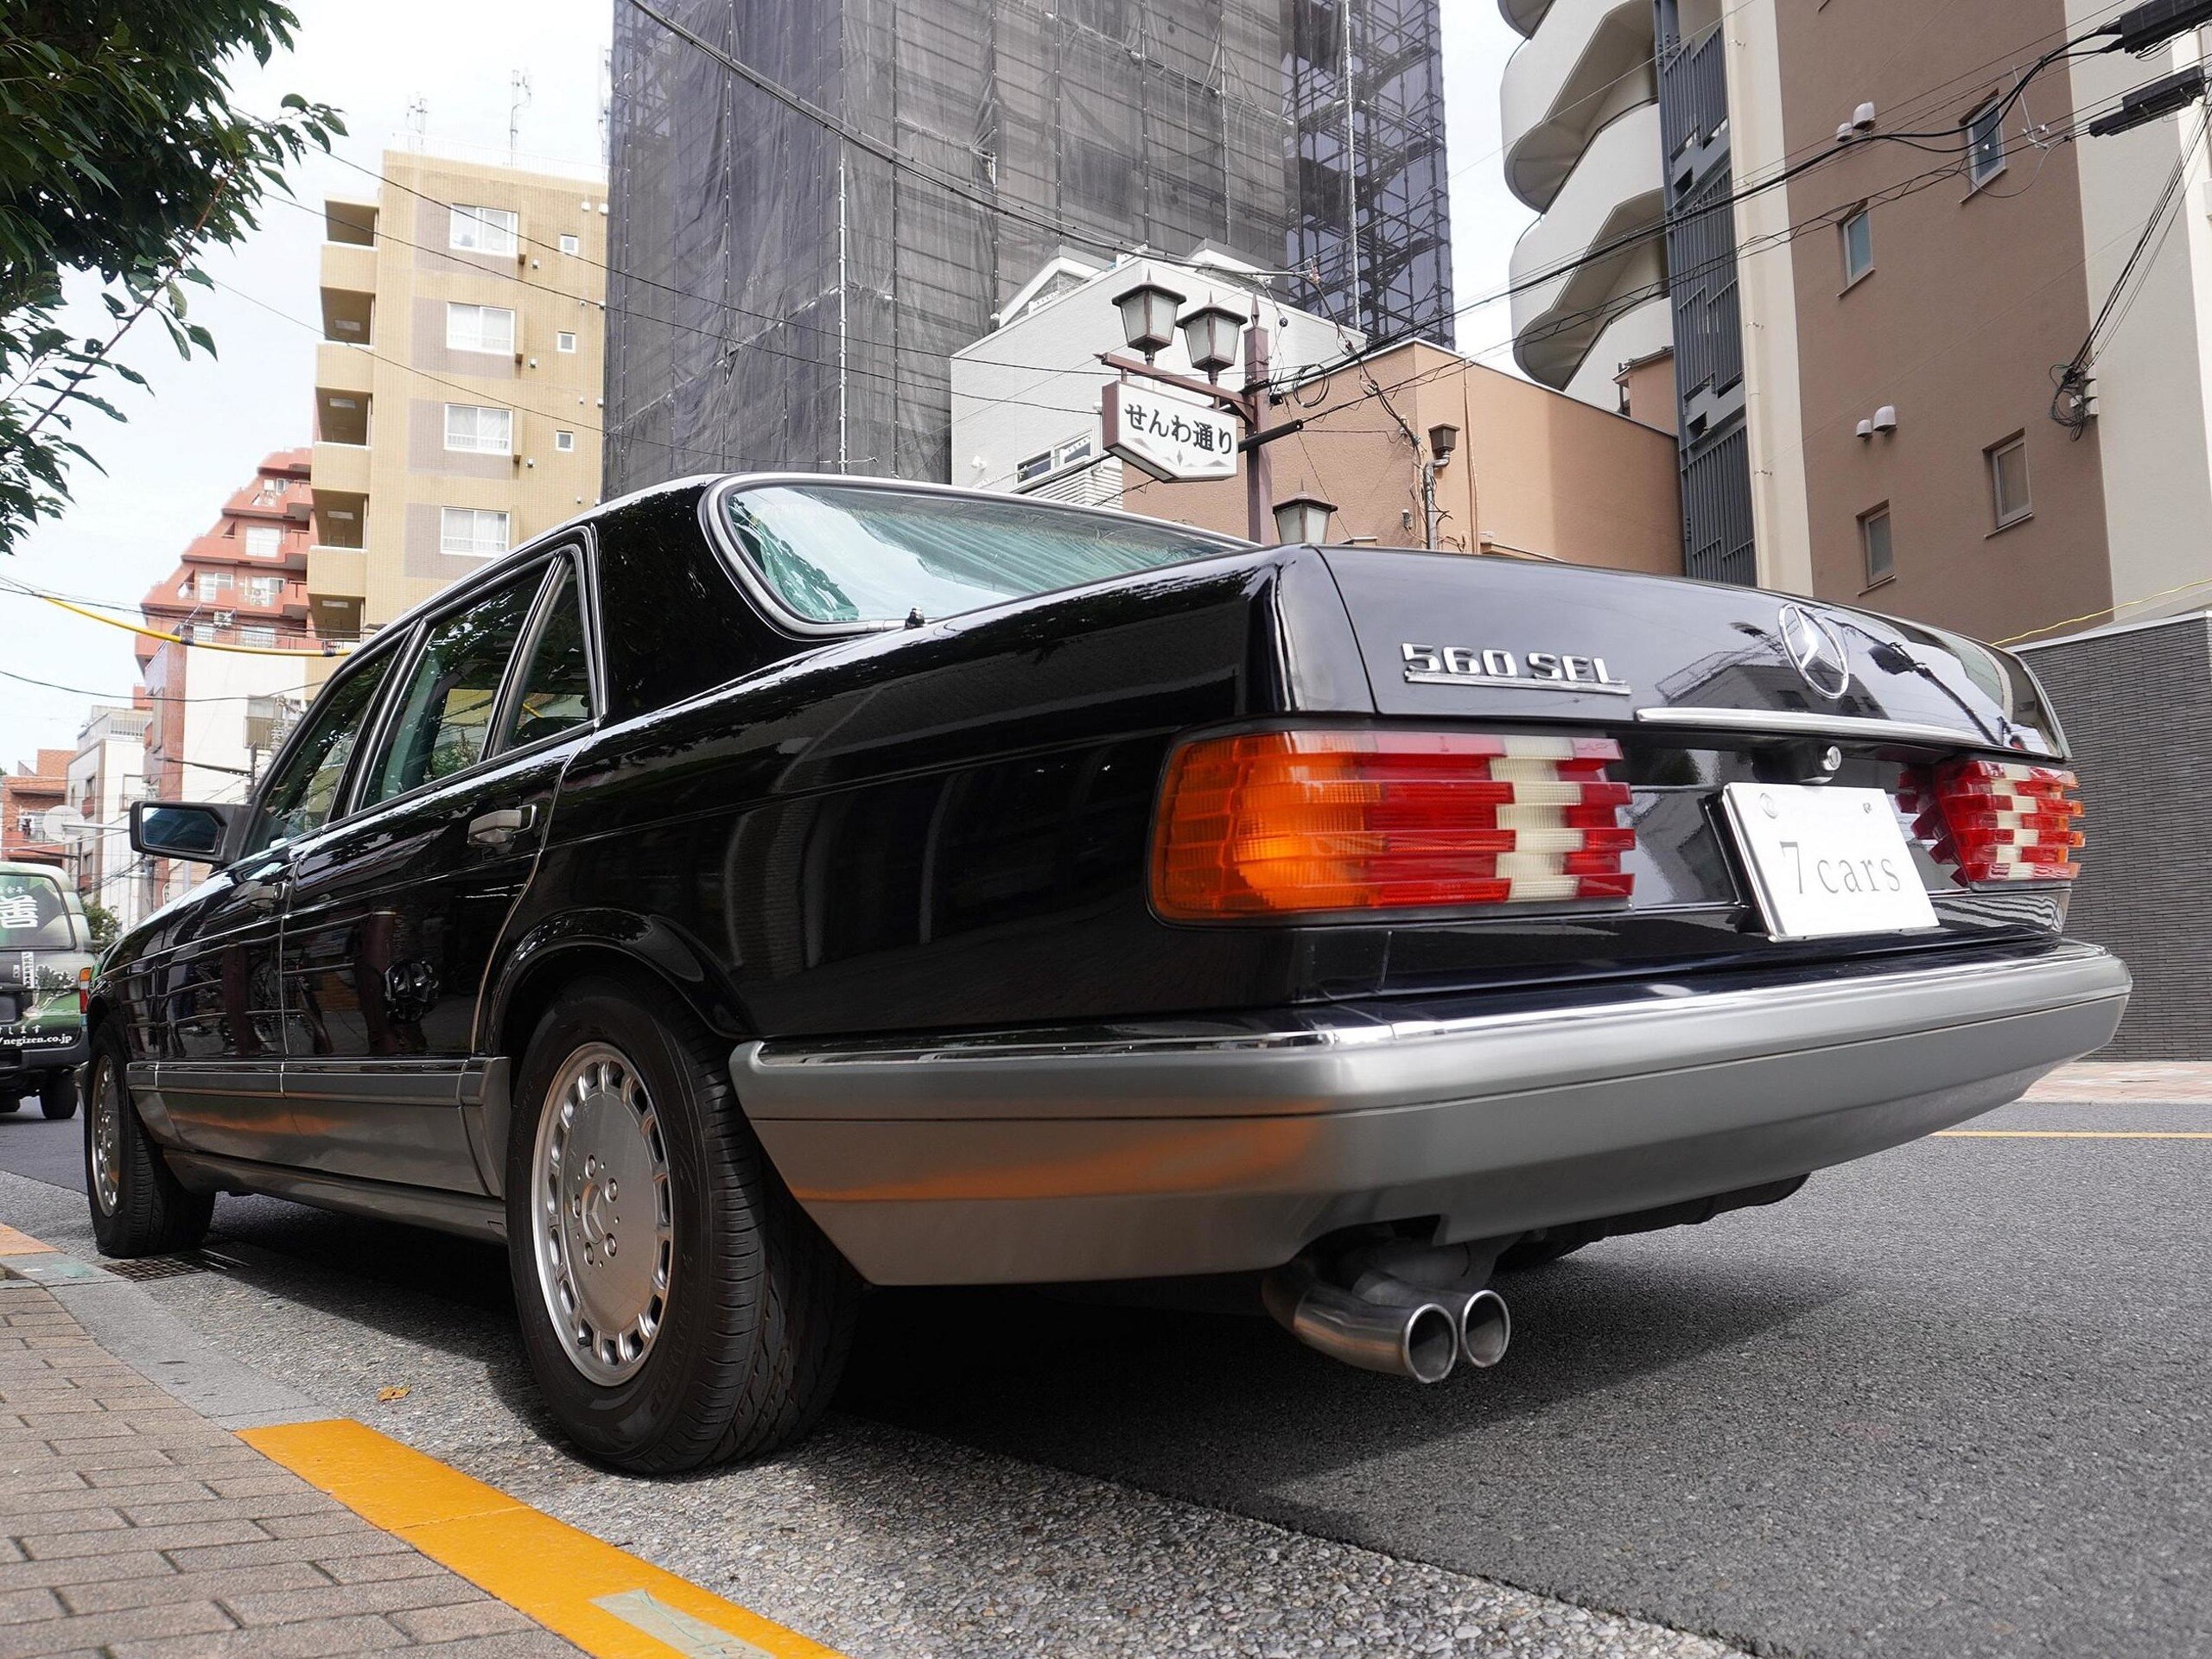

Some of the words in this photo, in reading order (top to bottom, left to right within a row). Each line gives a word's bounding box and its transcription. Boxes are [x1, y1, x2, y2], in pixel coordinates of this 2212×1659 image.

[1124, 404, 1232, 454] せんわ通り
[1402, 643, 1519, 677] 560
[1528, 652, 1627, 684] SEL
[1779, 841, 1803, 894] 7
[1817, 858, 1901, 894] cars
